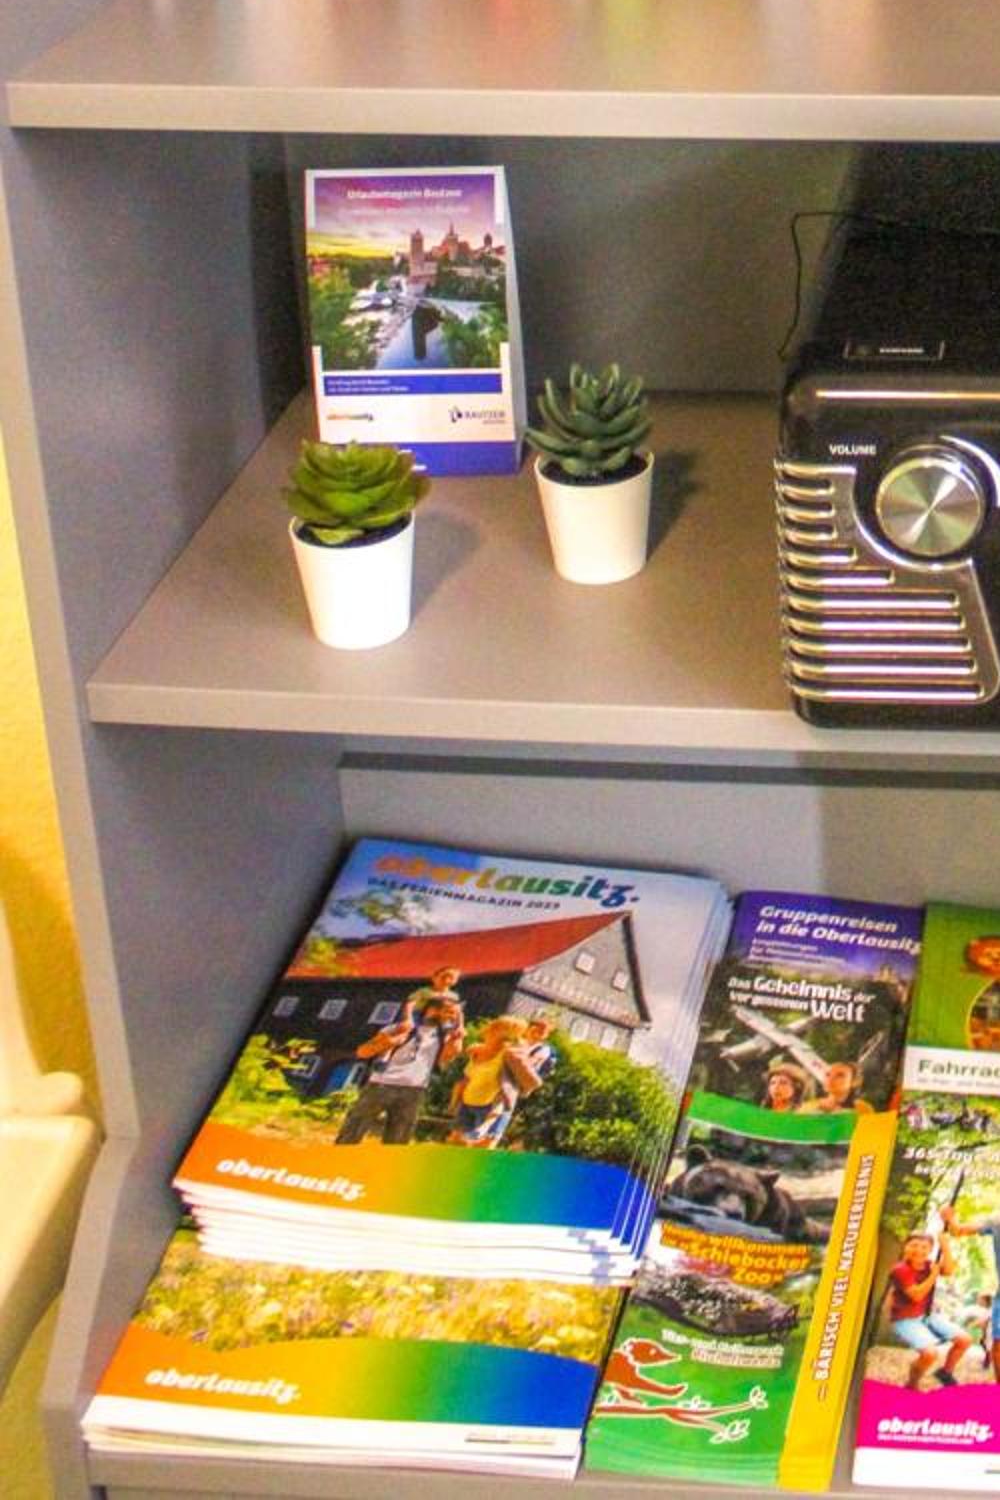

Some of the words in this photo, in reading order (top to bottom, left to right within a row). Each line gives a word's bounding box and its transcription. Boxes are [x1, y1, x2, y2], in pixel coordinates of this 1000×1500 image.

[828, 443, 877, 456] VOLUME
[399, 882, 522, 909] FERIENMAGAZIN
[759, 905, 898, 934] Gruppenreisen
[755, 919, 775, 934] in
[777, 921, 810, 939] die
[811, 927, 923, 957] Oberlausitz
[753, 974, 853, 1002] Geheimnis
[853, 990, 877, 1004] der
[810, 999, 866, 1024] Welt
[838, 1154, 876, 1272] NATURERLEBNIS
[831, 1274, 850, 1307] VIEL
